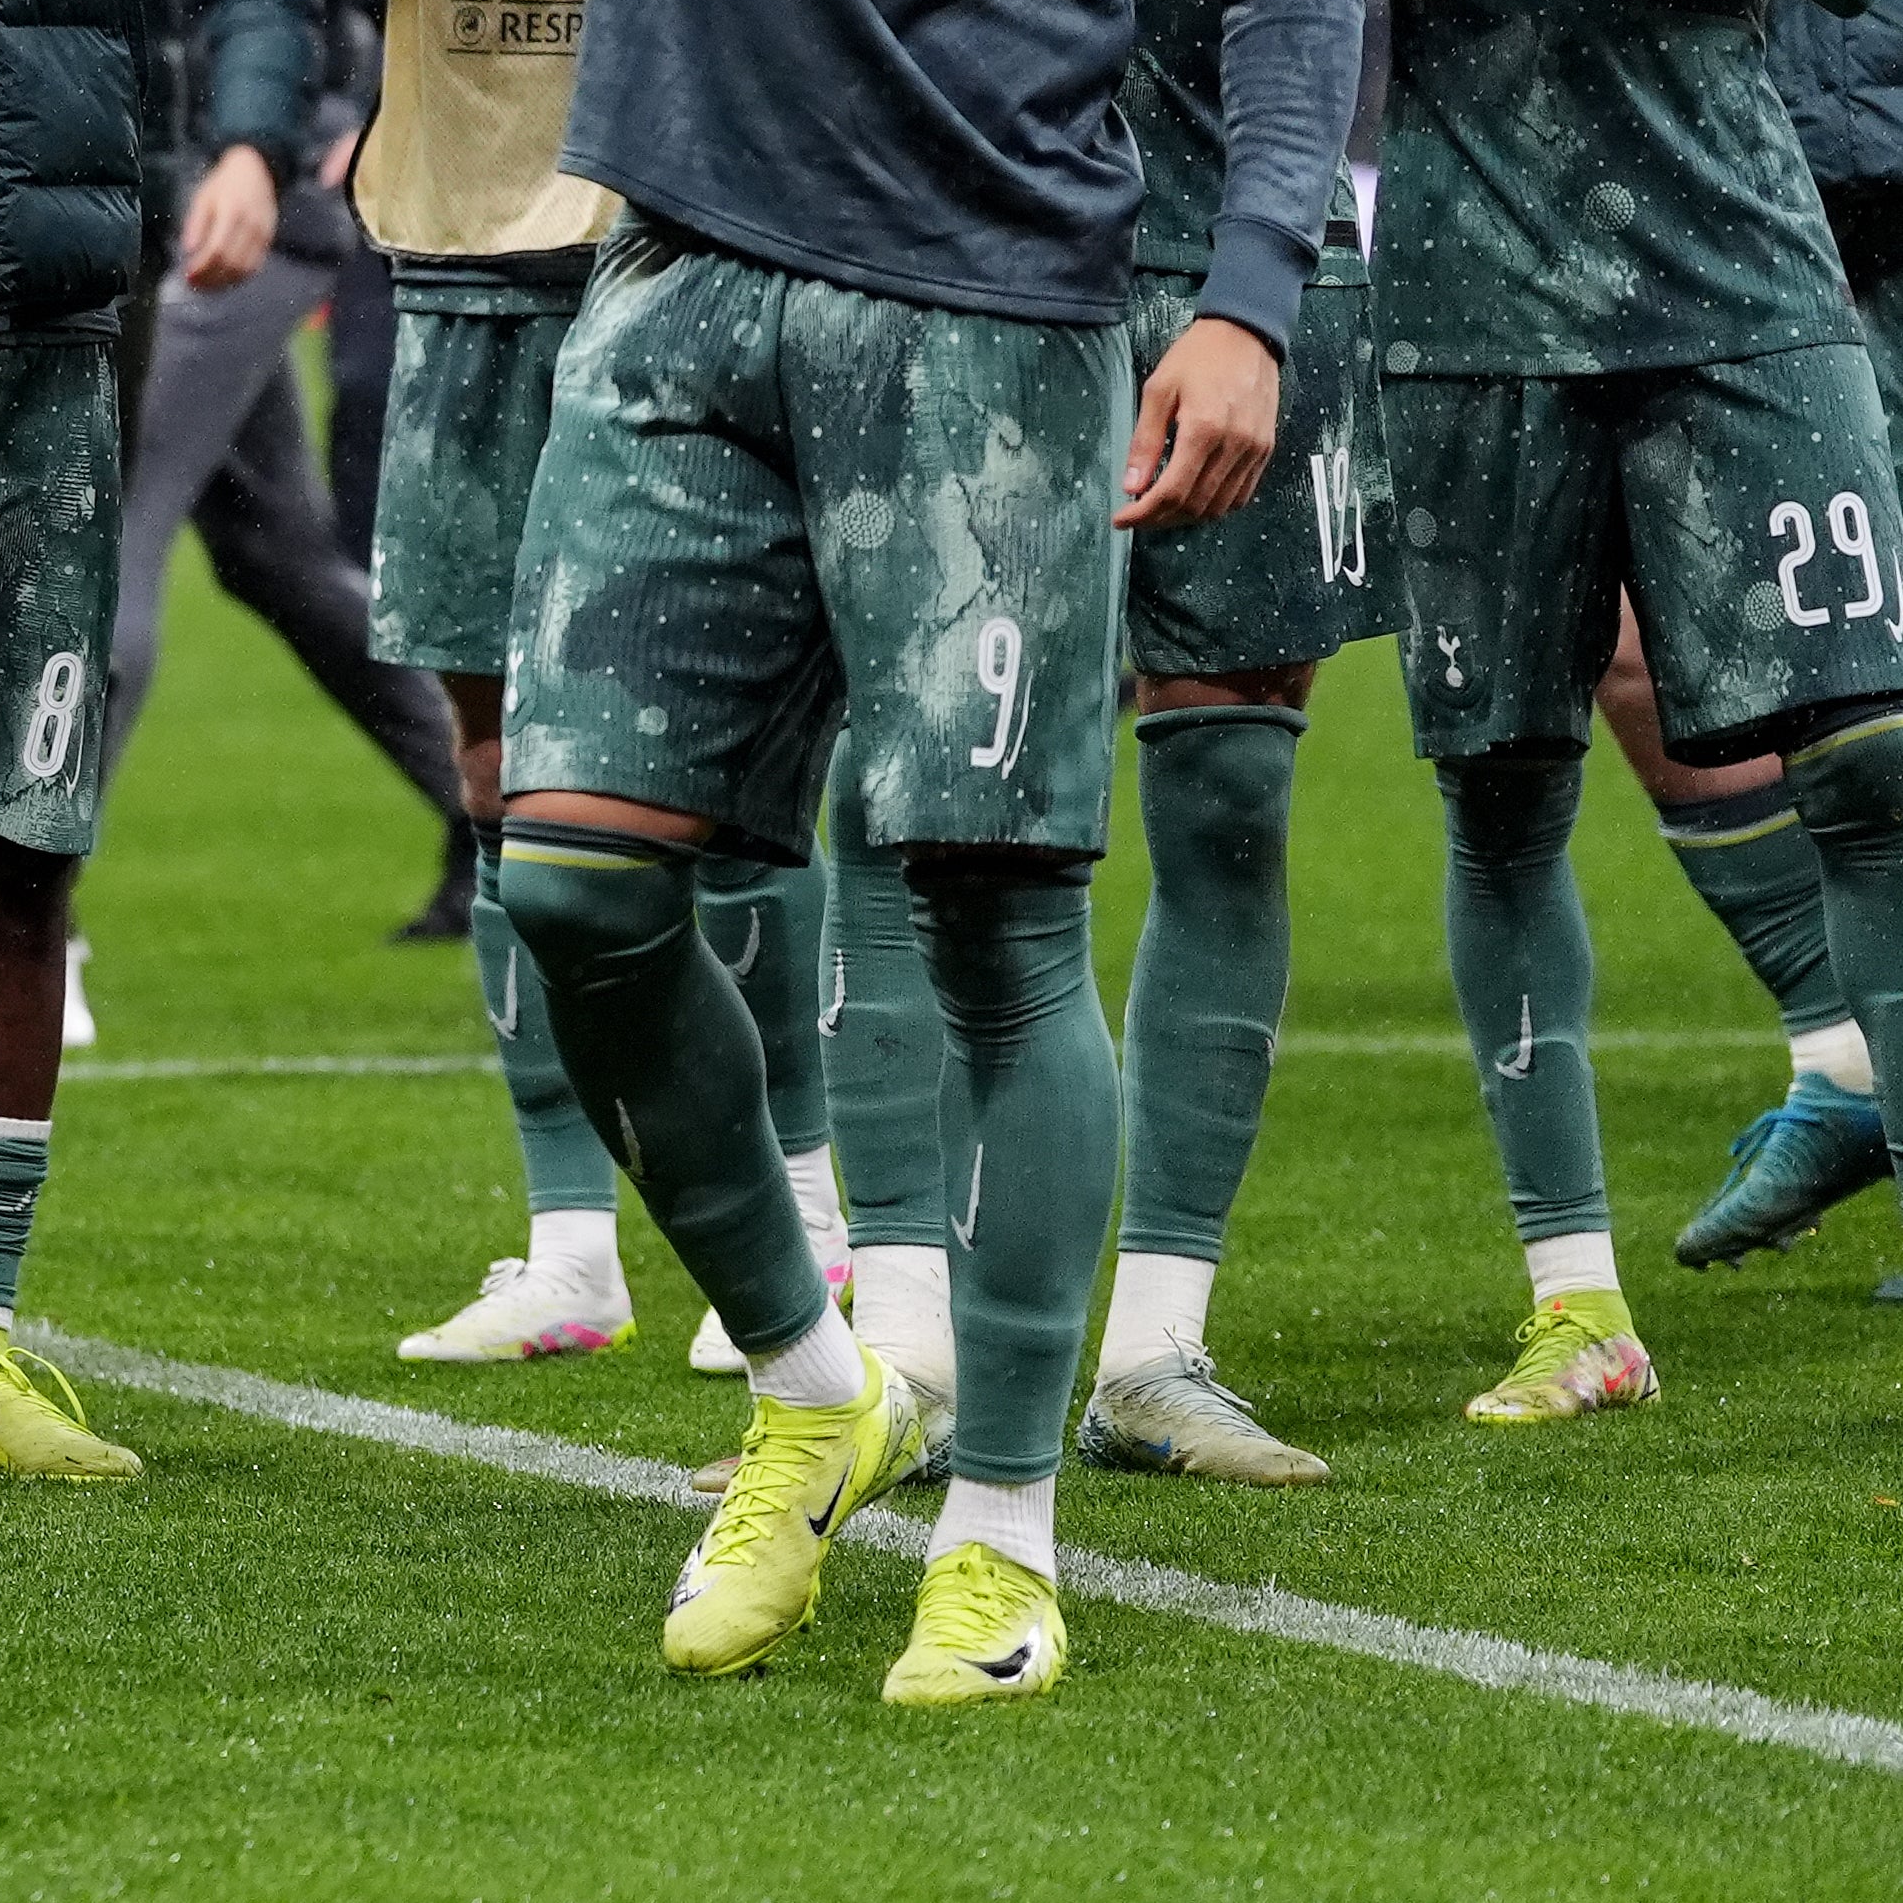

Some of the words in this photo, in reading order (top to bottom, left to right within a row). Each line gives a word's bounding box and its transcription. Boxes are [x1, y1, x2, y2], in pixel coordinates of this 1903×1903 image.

[1769, 491, 1884, 628] 29
[23, 651, 84, 779] 8
[970, 617, 1023, 769] 9
